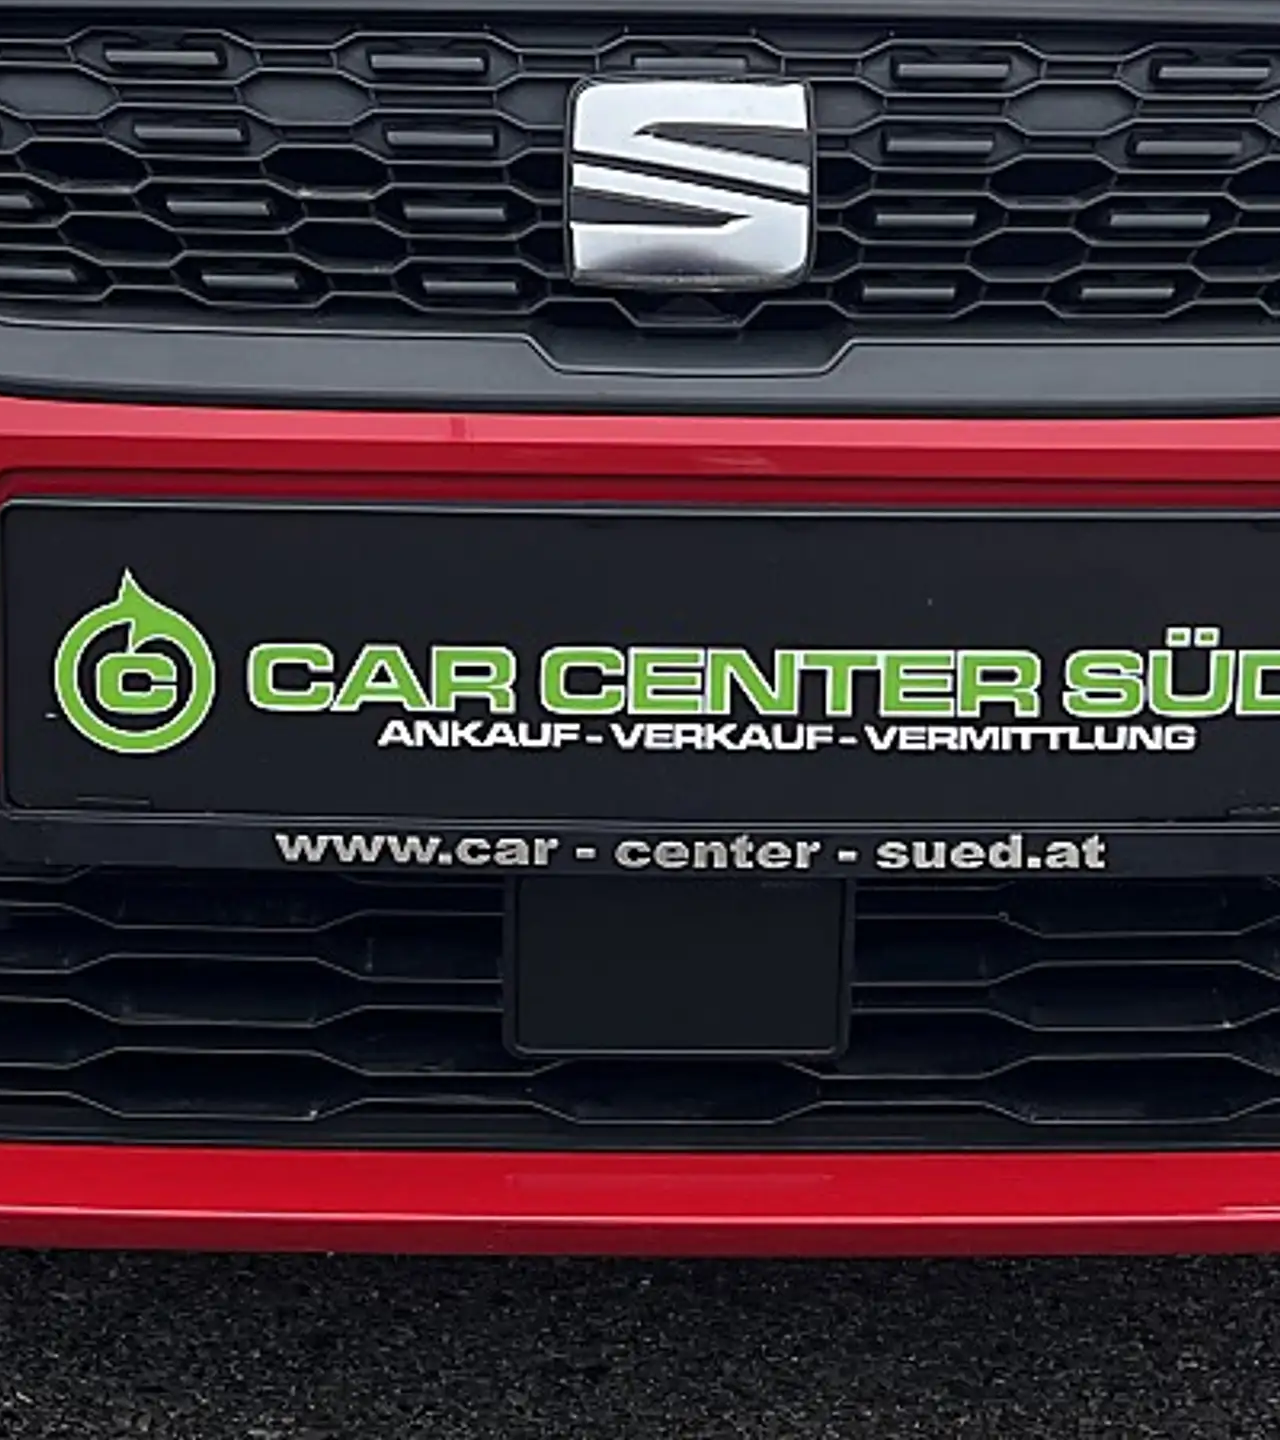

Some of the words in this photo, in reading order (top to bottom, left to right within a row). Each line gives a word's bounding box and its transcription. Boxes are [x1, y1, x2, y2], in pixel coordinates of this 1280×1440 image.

[247, 643, 517, 714] CAR
[540, 645, 1042, 718] CENTER
[377, 719, 581, 748] ANKAUF
[609, 722, 835, 751] VERKAUF
[863, 724, 1198, 752] VERMITTLUNG
[275, 832, 559, 866] www.car
[614, 833, 822, 870] center
[876, 832, 1107, 870] sued.at
